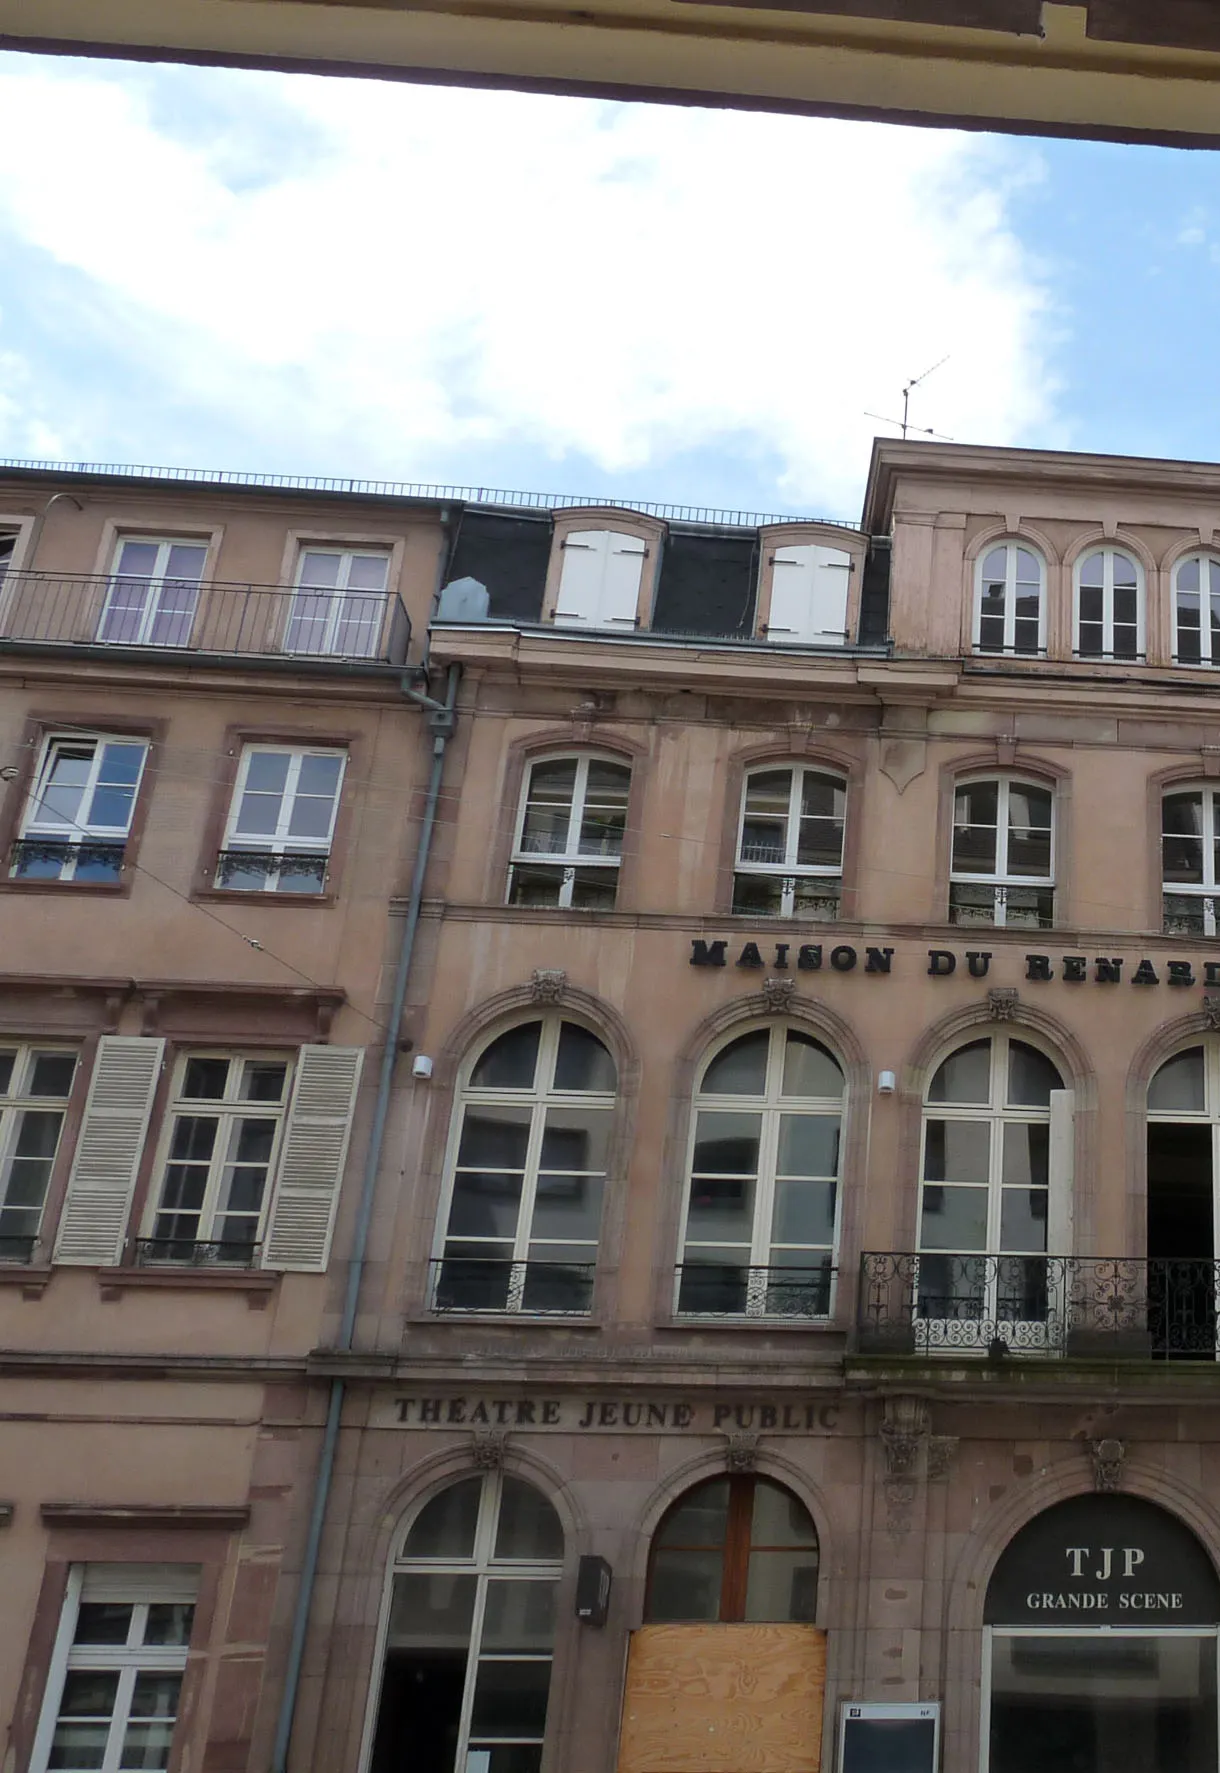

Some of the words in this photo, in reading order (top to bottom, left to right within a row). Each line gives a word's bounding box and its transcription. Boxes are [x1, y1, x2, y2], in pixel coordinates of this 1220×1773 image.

[690, 939, 895, 973] MAISON
[927, 949, 993, 978] DU
[579, 1402, 692, 1429] JEUNE
[712, 1403, 839, 1430] PUBLIC
[1066, 1548, 1145, 1580] TJP
[1026, 1593, 1109, 1609] GRANDE
[1119, 1593, 1183, 1609] SCENE
